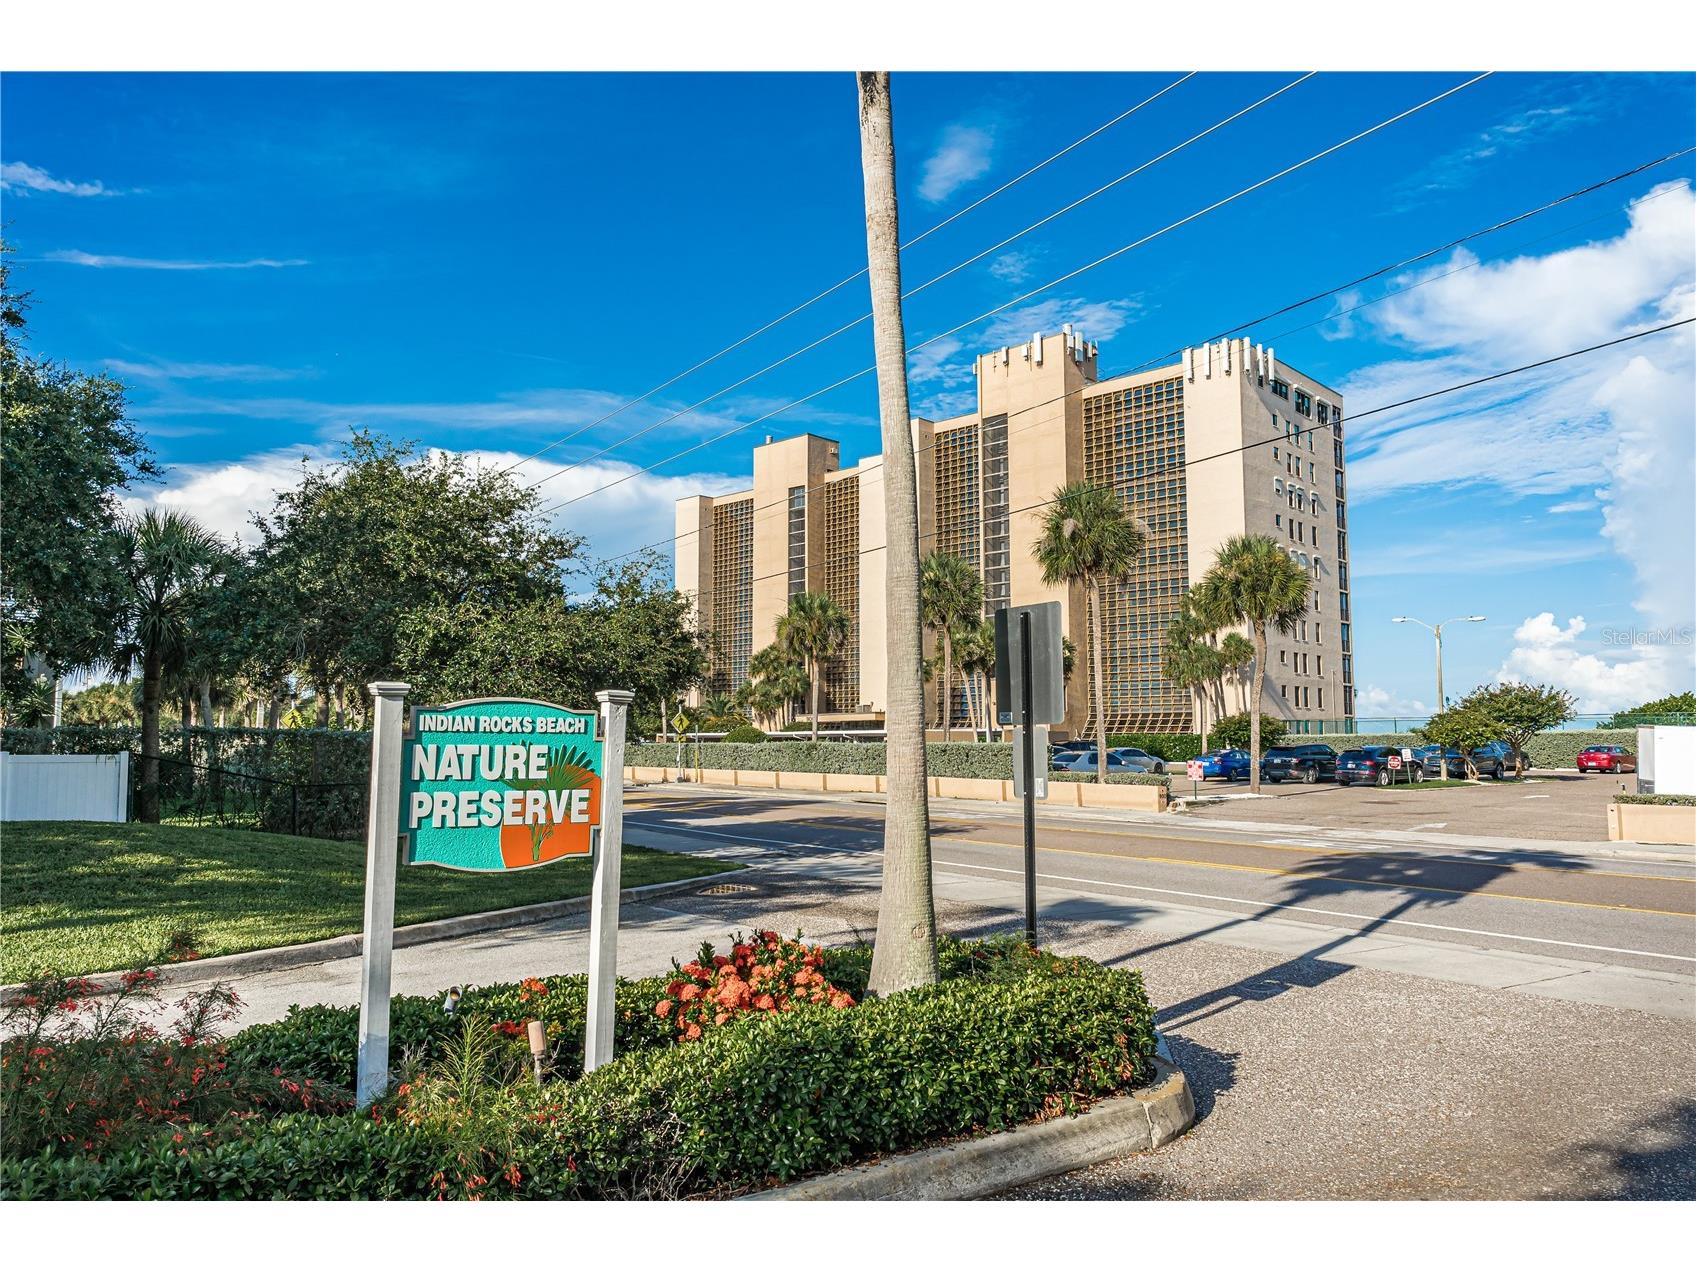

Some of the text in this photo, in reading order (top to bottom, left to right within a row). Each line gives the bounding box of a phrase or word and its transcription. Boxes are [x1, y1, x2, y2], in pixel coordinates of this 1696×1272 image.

[419, 714, 585, 733] INDIAN ROCKS BEACH
[411, 744, 549, 781] NATURE
[408, 789, 590, 829] PRESERVE
